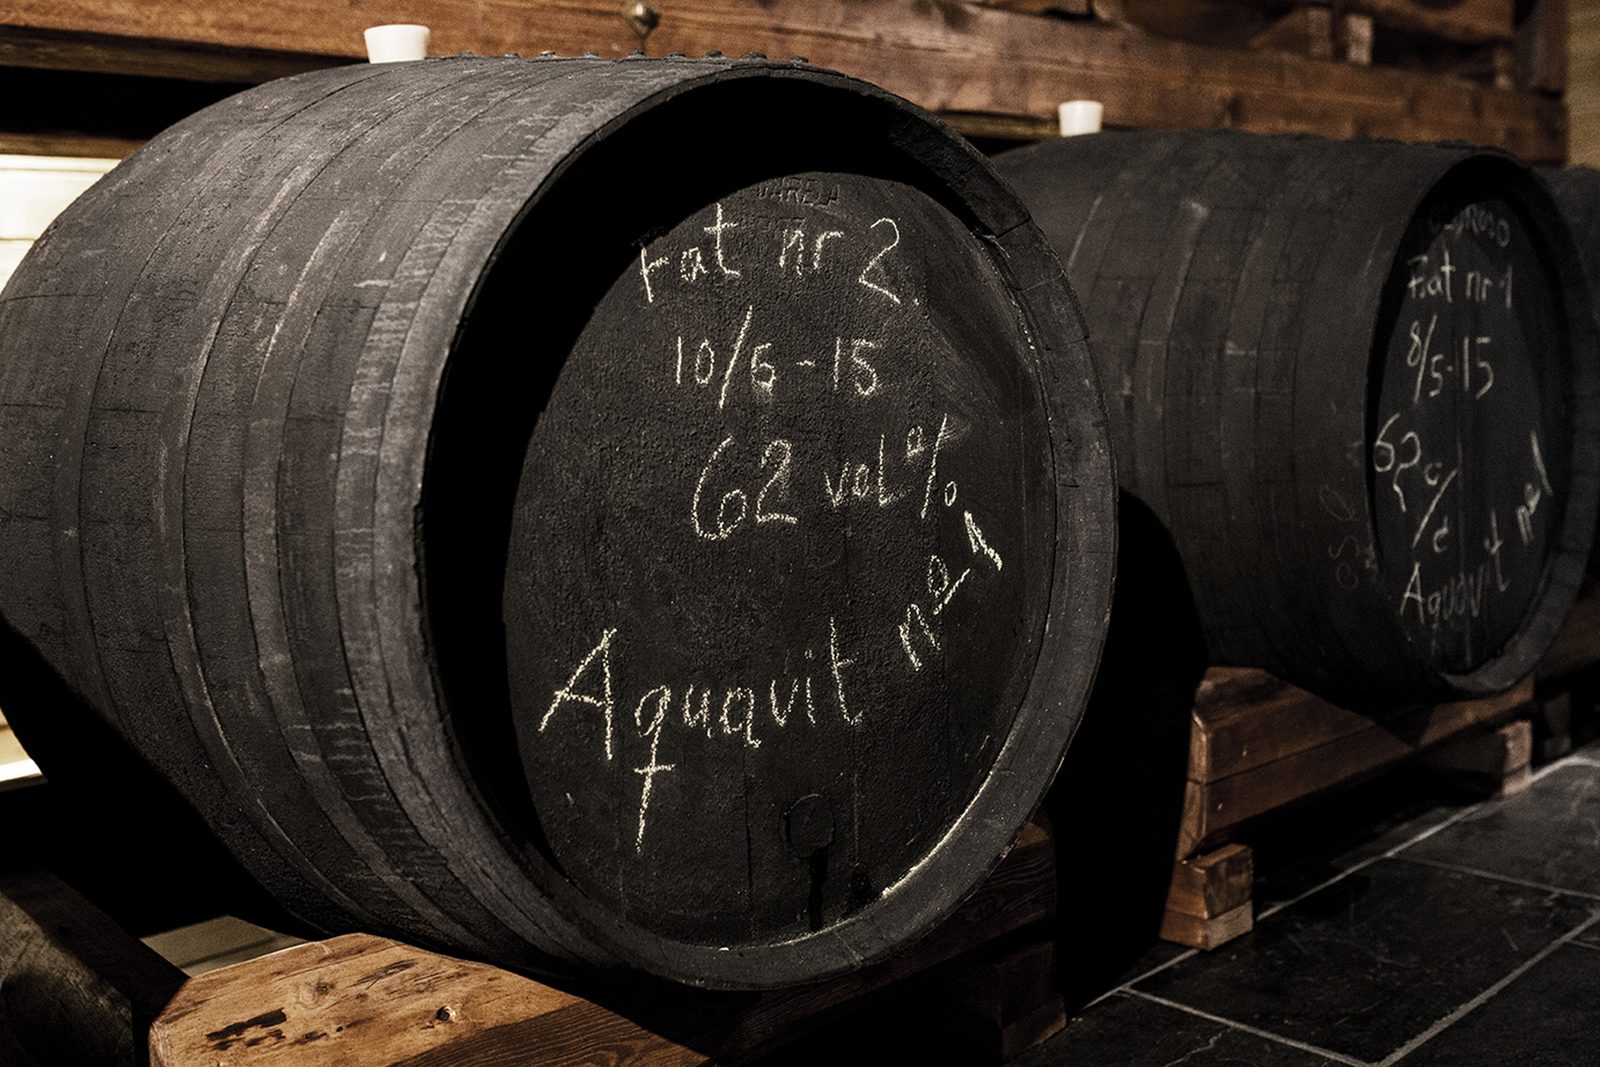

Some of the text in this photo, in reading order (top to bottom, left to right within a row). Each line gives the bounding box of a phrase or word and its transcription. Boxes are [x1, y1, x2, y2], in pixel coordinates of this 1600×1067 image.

[638, 201, 902, 305] Fat nr 2
[1465, 270, 1493, 301] nr
[691, 434, 800, 543] 62
